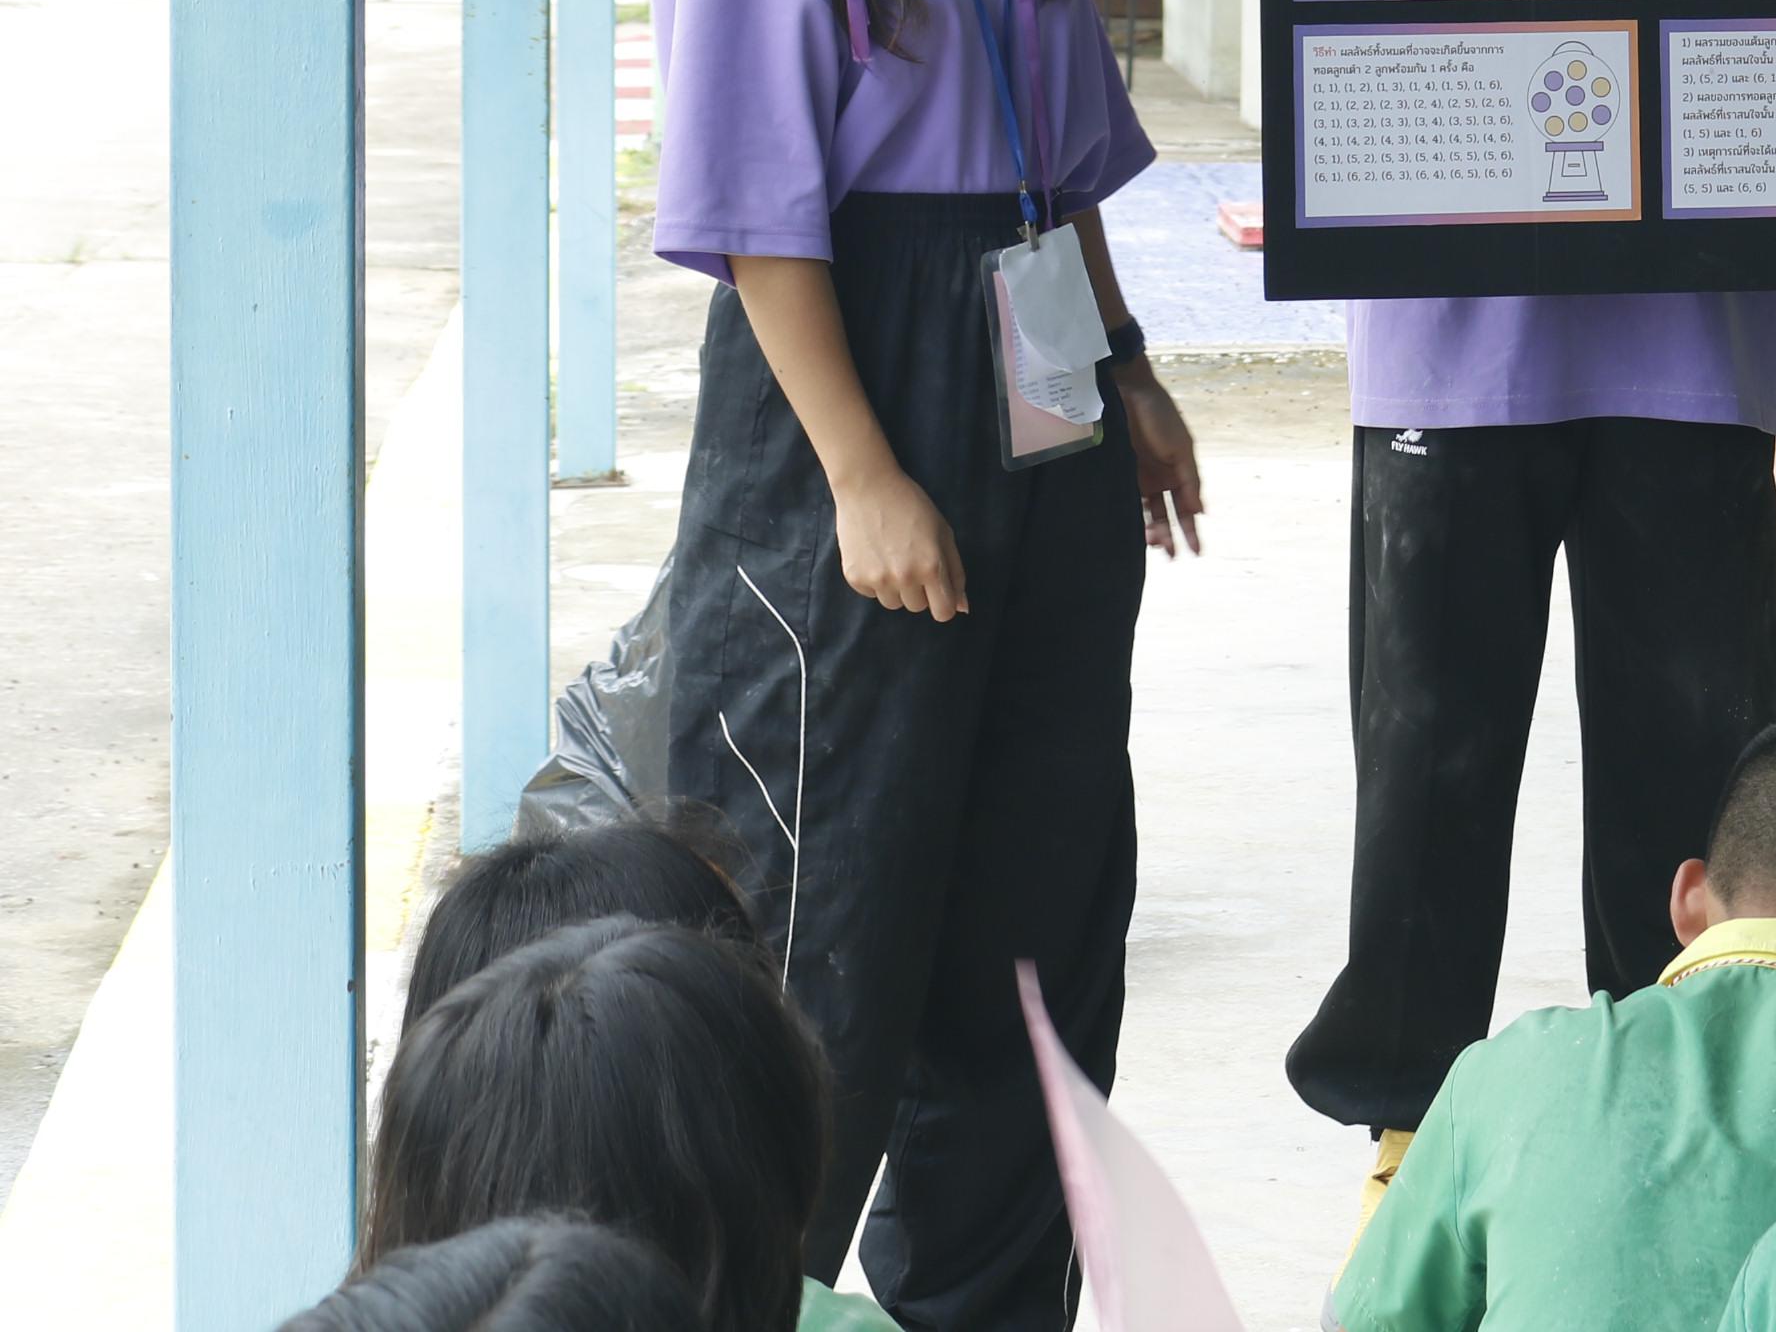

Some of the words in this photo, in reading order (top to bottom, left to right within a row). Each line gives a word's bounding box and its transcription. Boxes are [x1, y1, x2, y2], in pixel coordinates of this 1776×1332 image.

[1683, 38, 1690, 48] 1)
[1313, 47, 1336, 57] วิธีทำ
[1313, 64, 1360, 78] ทอดลูกเต๋า
[1365, 65, 1371, 74] 2
[1375, 63, 1427, 77] ลูกพร้อมกัน
[1431, 64, 1435, 73] 1
[1440, 59, 1457, 72] ครั้ง
[1462, 62, 1474, 72] คือ
[1684, 183, 1697, 194] (5,
[1702, 183, 1712, 193] 5)
[1738, 183, 1751, 193] (6,
[1756, 182, 1766, 192] 6)
